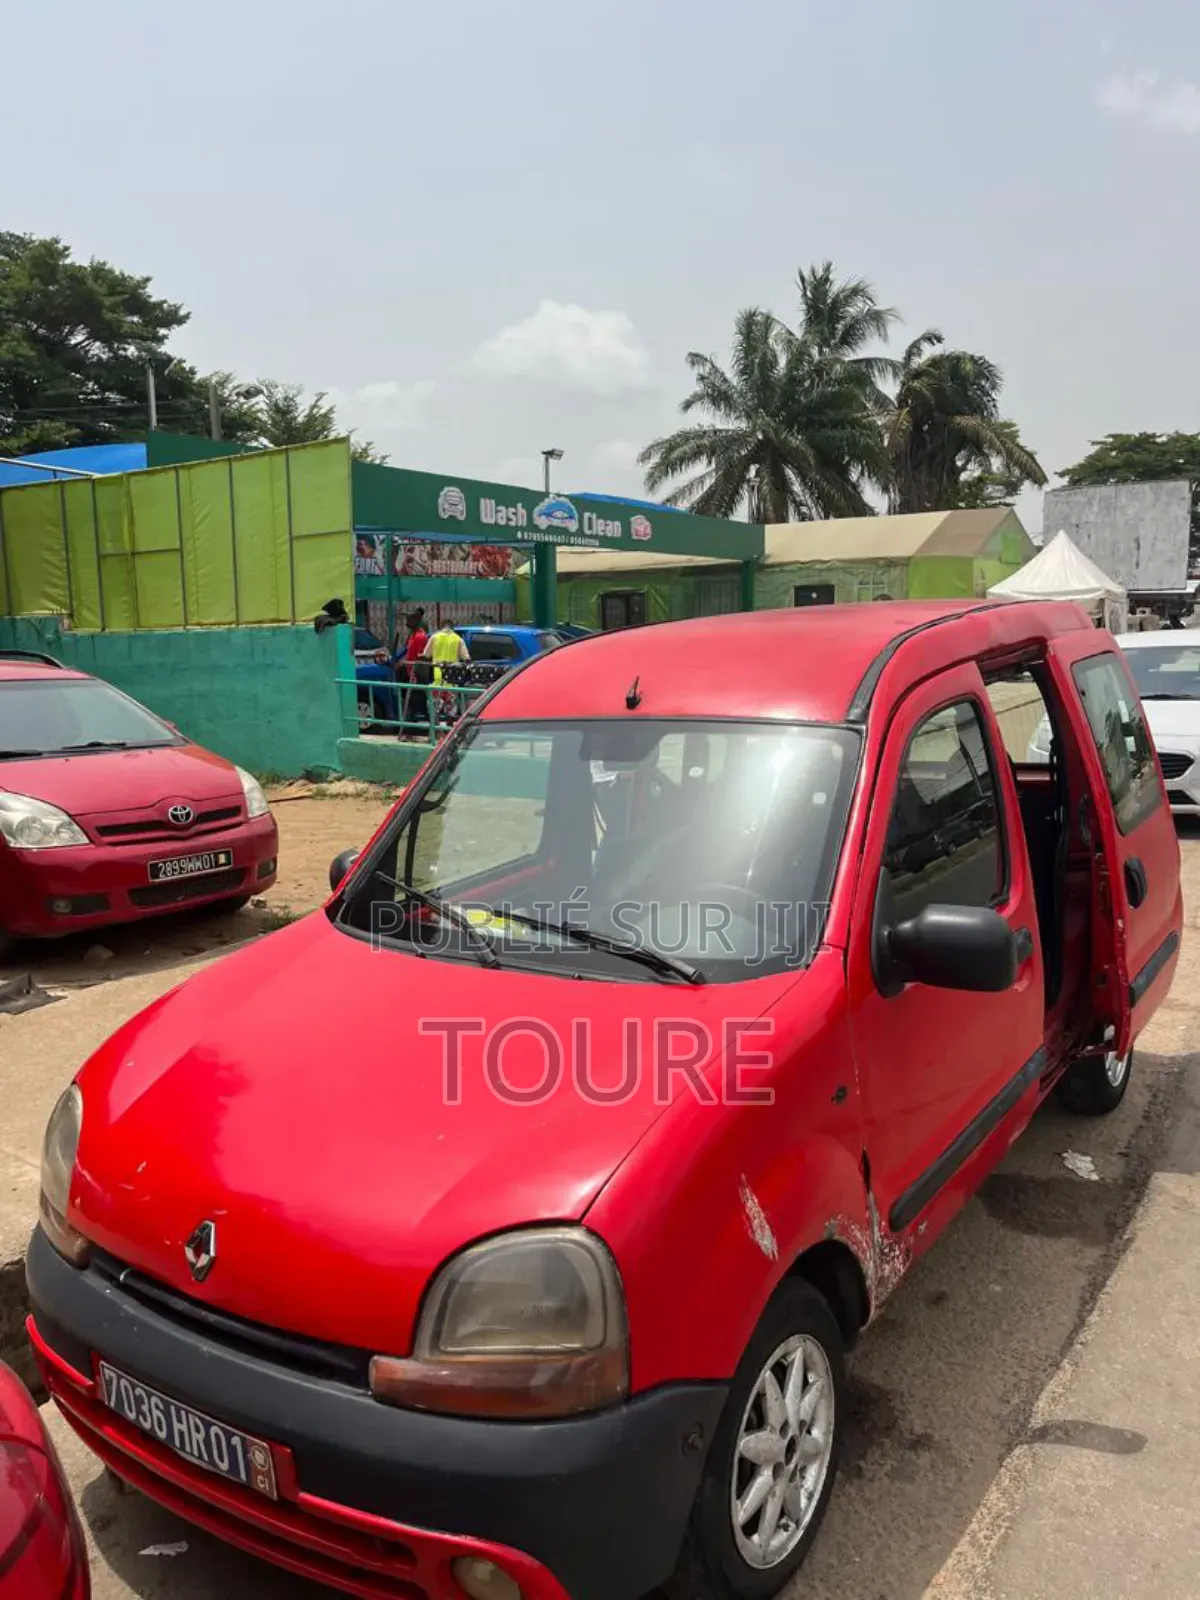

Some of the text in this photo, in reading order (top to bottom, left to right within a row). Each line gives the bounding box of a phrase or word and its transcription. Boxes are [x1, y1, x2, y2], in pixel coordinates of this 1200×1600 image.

[480, 498, 621, 538] Wash Clean
[158, 853, 216, 878] 2899WW01
